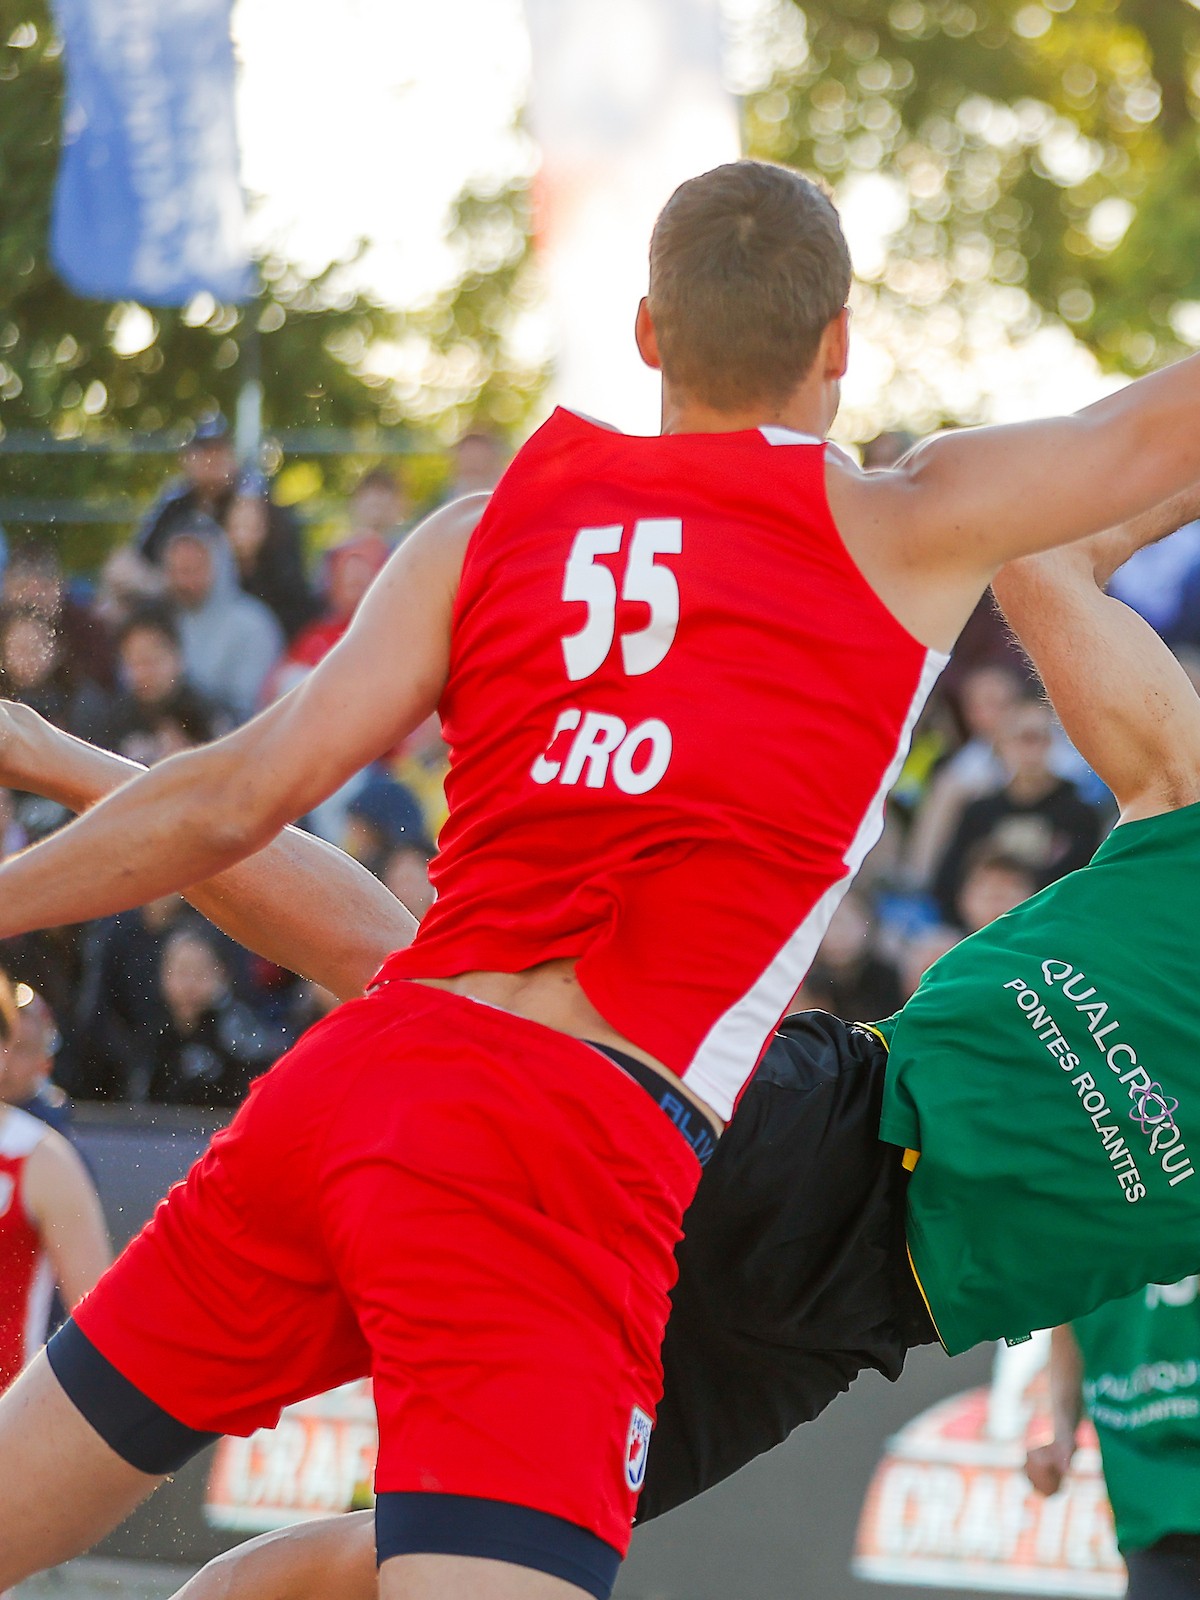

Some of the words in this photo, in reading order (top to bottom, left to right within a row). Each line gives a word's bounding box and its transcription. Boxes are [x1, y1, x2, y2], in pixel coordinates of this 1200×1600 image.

[560, 516, 683, 682] 55
[530, 708, 673, 796] CRO
[1002, 977, 1082, 1073] PONTES
[1071, 1070, 1147, 1204] ROLANTES
[1040, 957, 1196, 1188] QUALCROQUI
